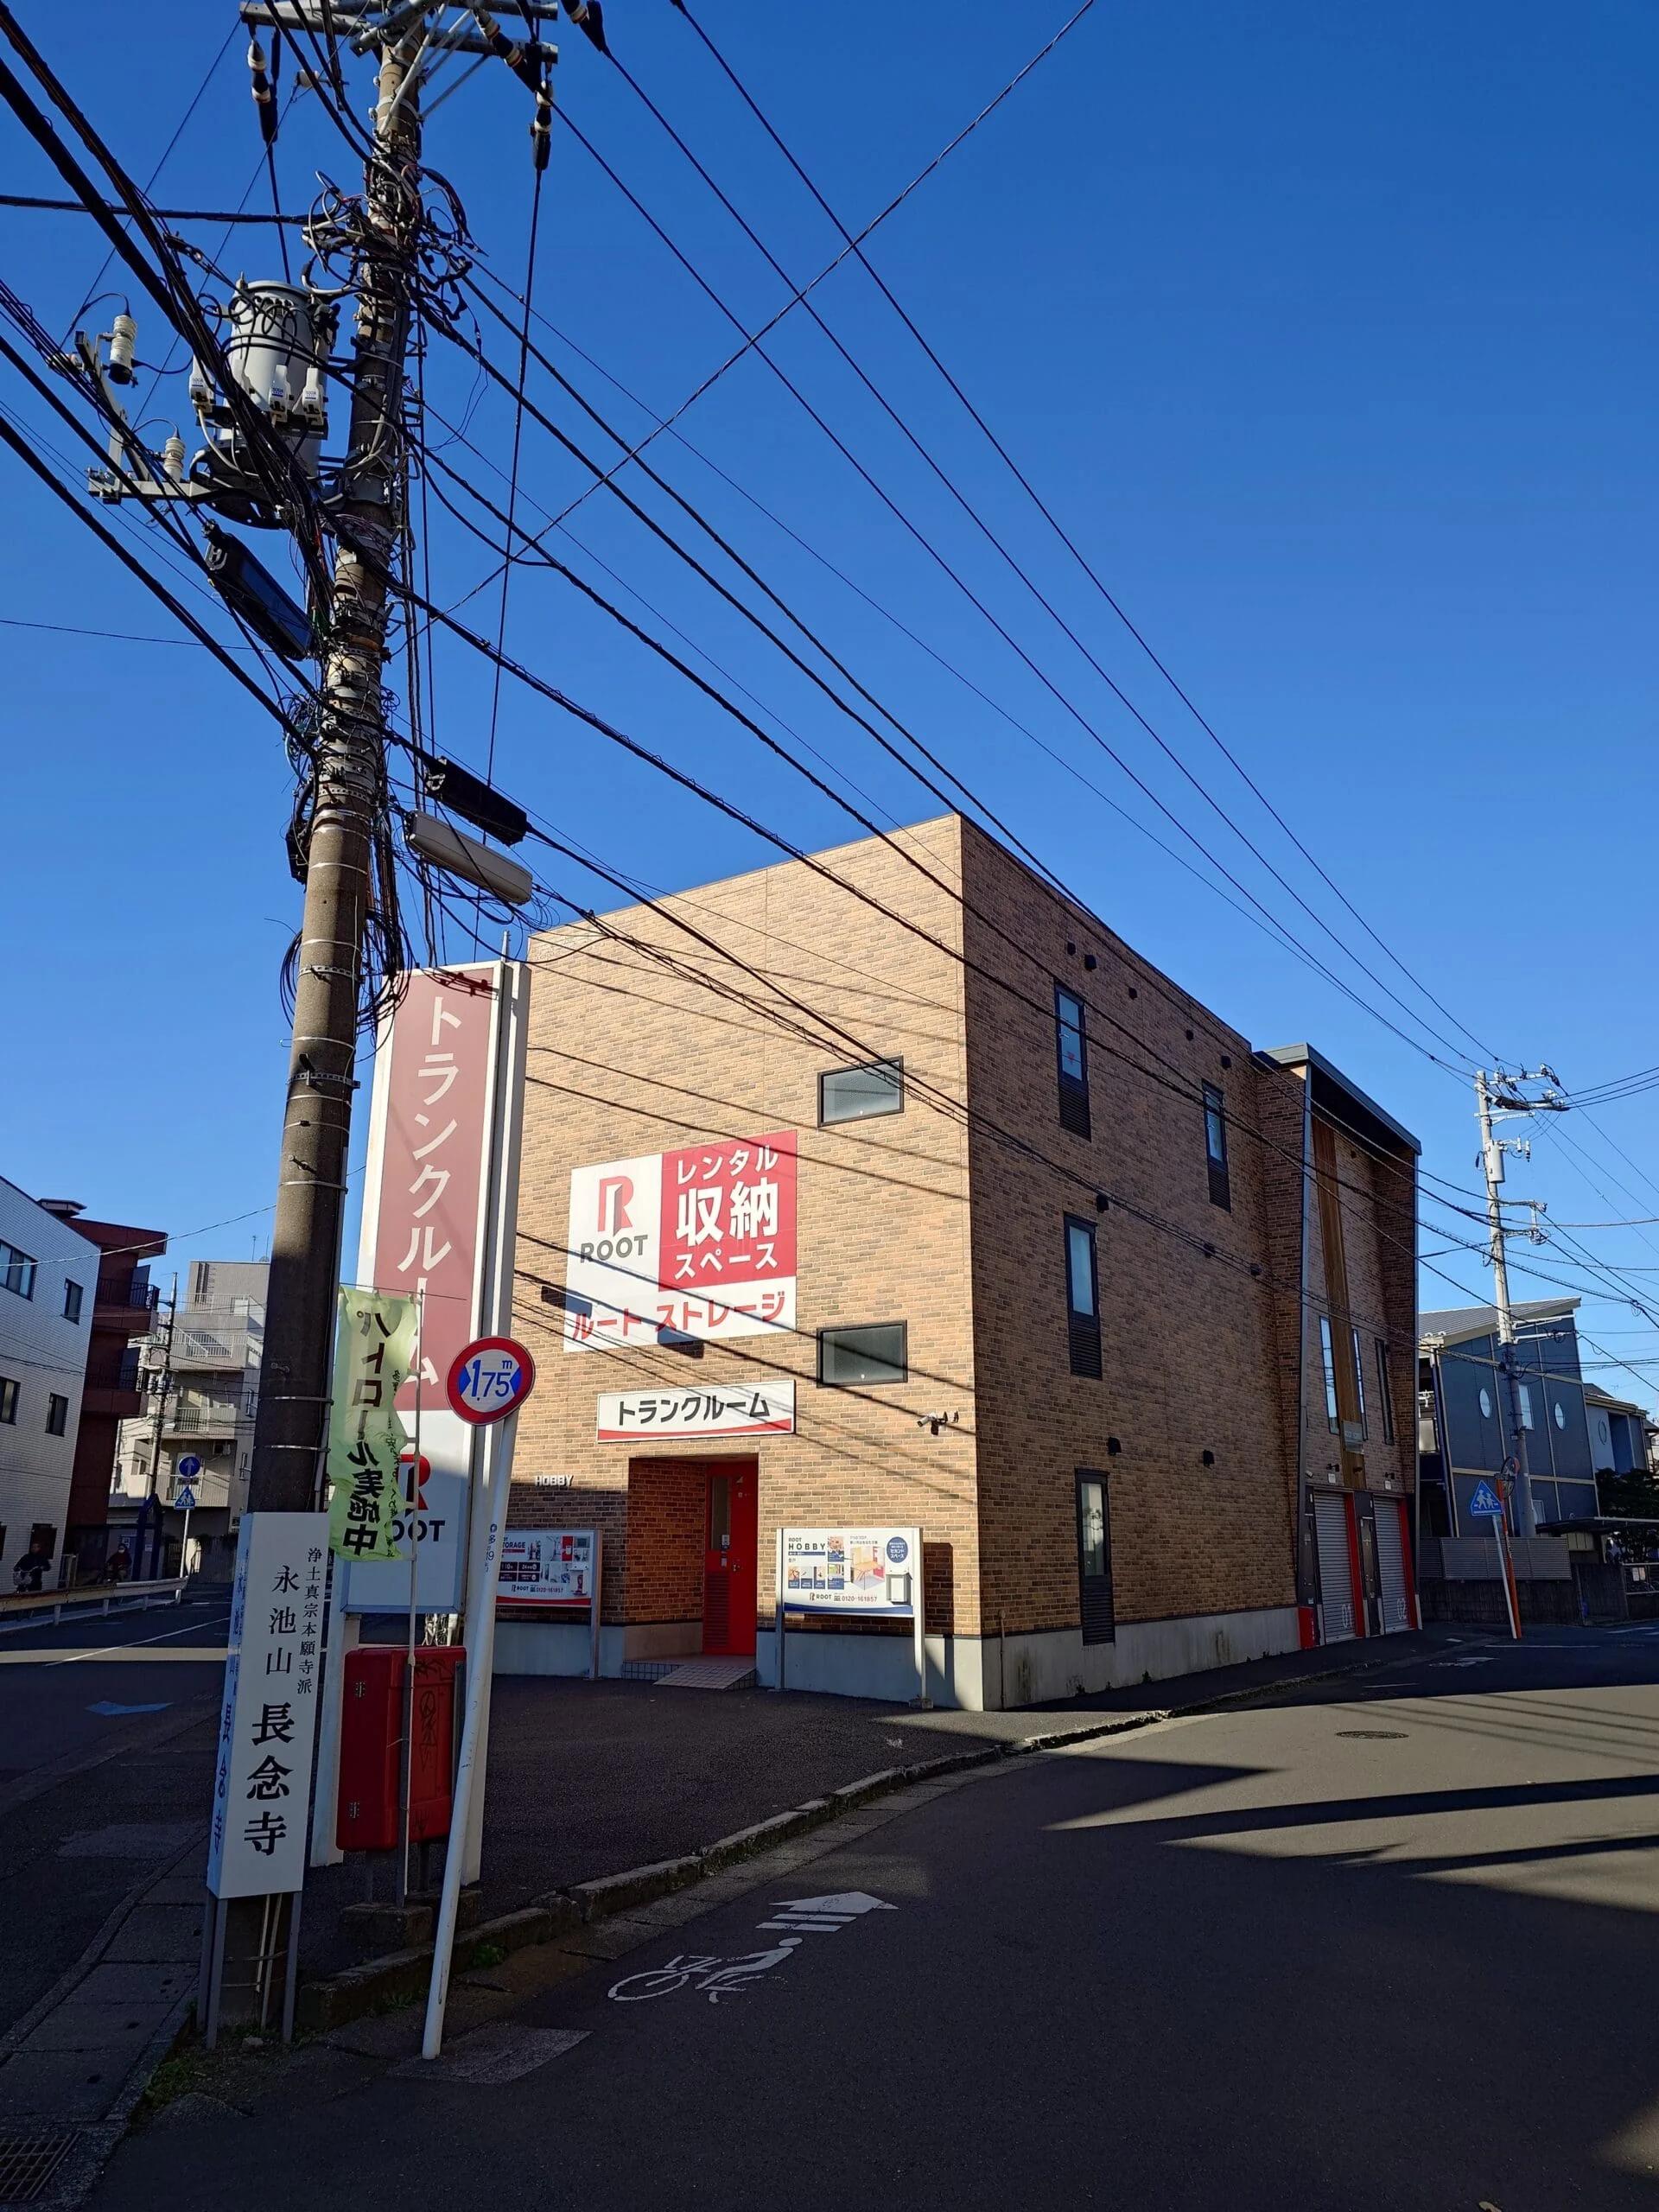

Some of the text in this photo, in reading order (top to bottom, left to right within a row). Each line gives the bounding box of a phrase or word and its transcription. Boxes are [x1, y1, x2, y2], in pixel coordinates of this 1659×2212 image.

[677, 1146, 779, 1185] レンタル
[675, 1180, 779, 1247] 収納
[580, 1235, 648, 1263] ROOT
[674, 1243, 779, 1281] スペース
[572, 1290, 785, 1341] ルート ストレージ
[472, 1359, 511, 1402] 1.75
[619, 1392, 771, 1426] トランクルーム
[535, 1474, 574, 1487] HOBBY
[391, 1520, 445, 1542] OOT
[297, 1547, 322, 1694] 浄土真宗本願寺派
[244, 1565, 301, 1856] 永池山 長念寺
